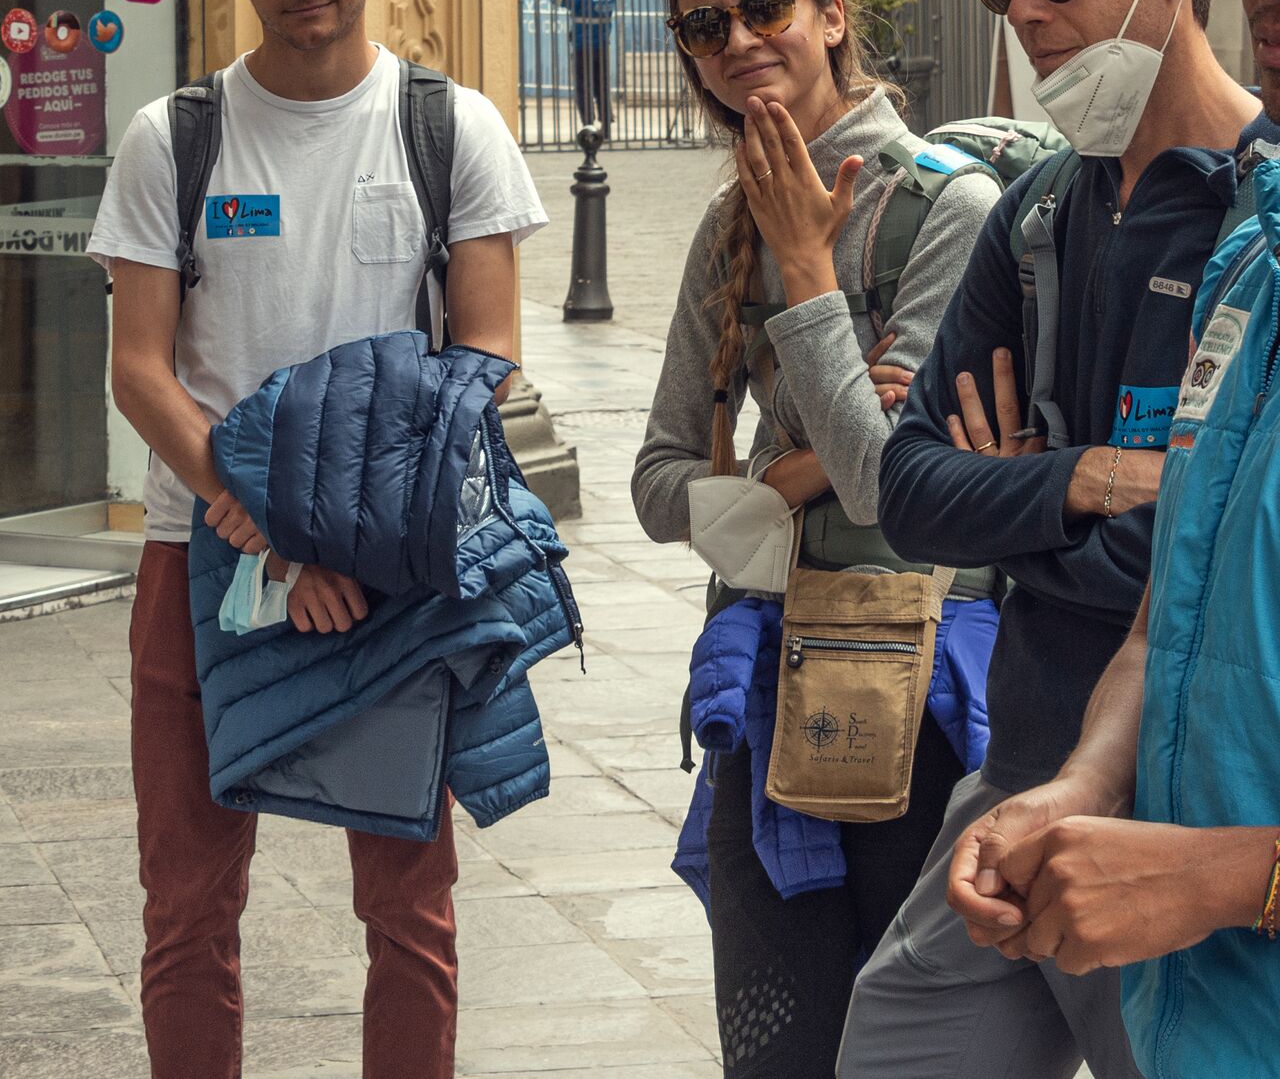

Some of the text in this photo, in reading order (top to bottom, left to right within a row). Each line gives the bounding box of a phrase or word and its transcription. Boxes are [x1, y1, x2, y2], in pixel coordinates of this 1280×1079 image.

[20, 68, 93, 85] RECOGE TUS
[17, 82, 97, 100] PEDIDOS WEB
[240, 201, 273, 219] Lima
[1134, 399, 1177, 421] Lima
